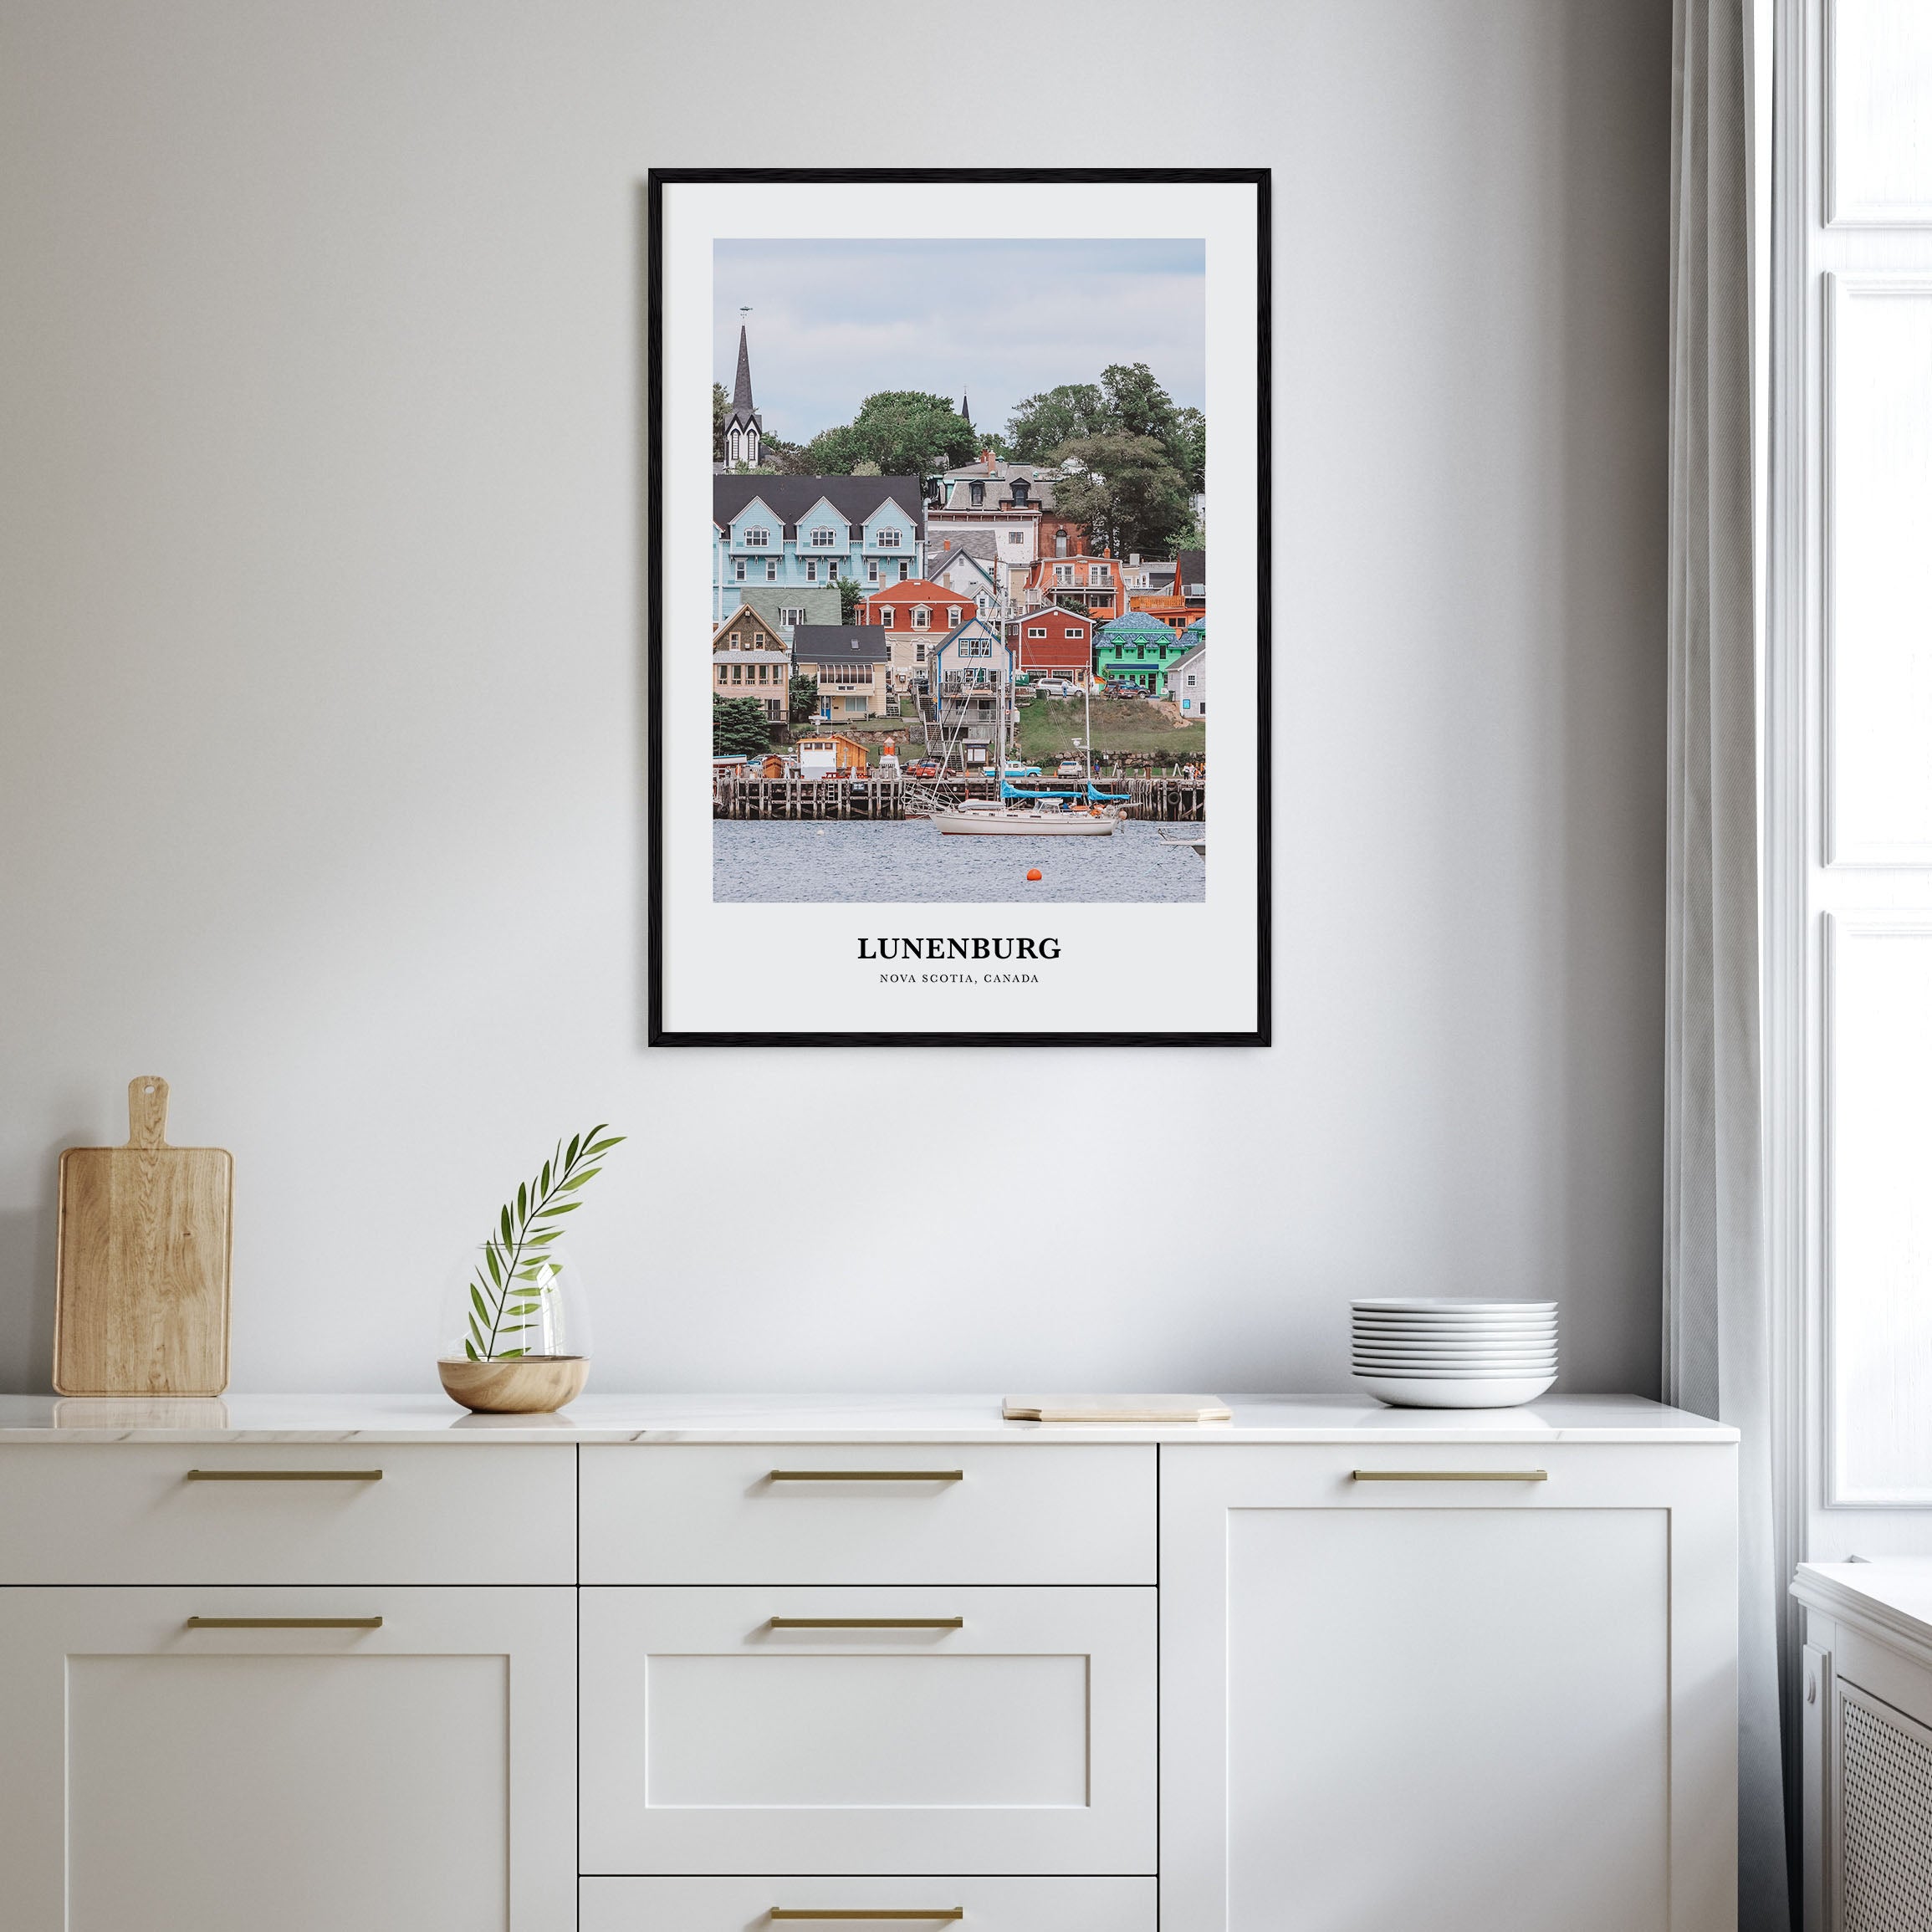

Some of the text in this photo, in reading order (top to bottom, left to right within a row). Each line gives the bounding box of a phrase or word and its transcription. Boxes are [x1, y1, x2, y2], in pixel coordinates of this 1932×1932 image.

[857, 938, 1061, 959] LUNENBURG
[879, 974, 1040, 985] NOVA SCOTIA, CANADA
